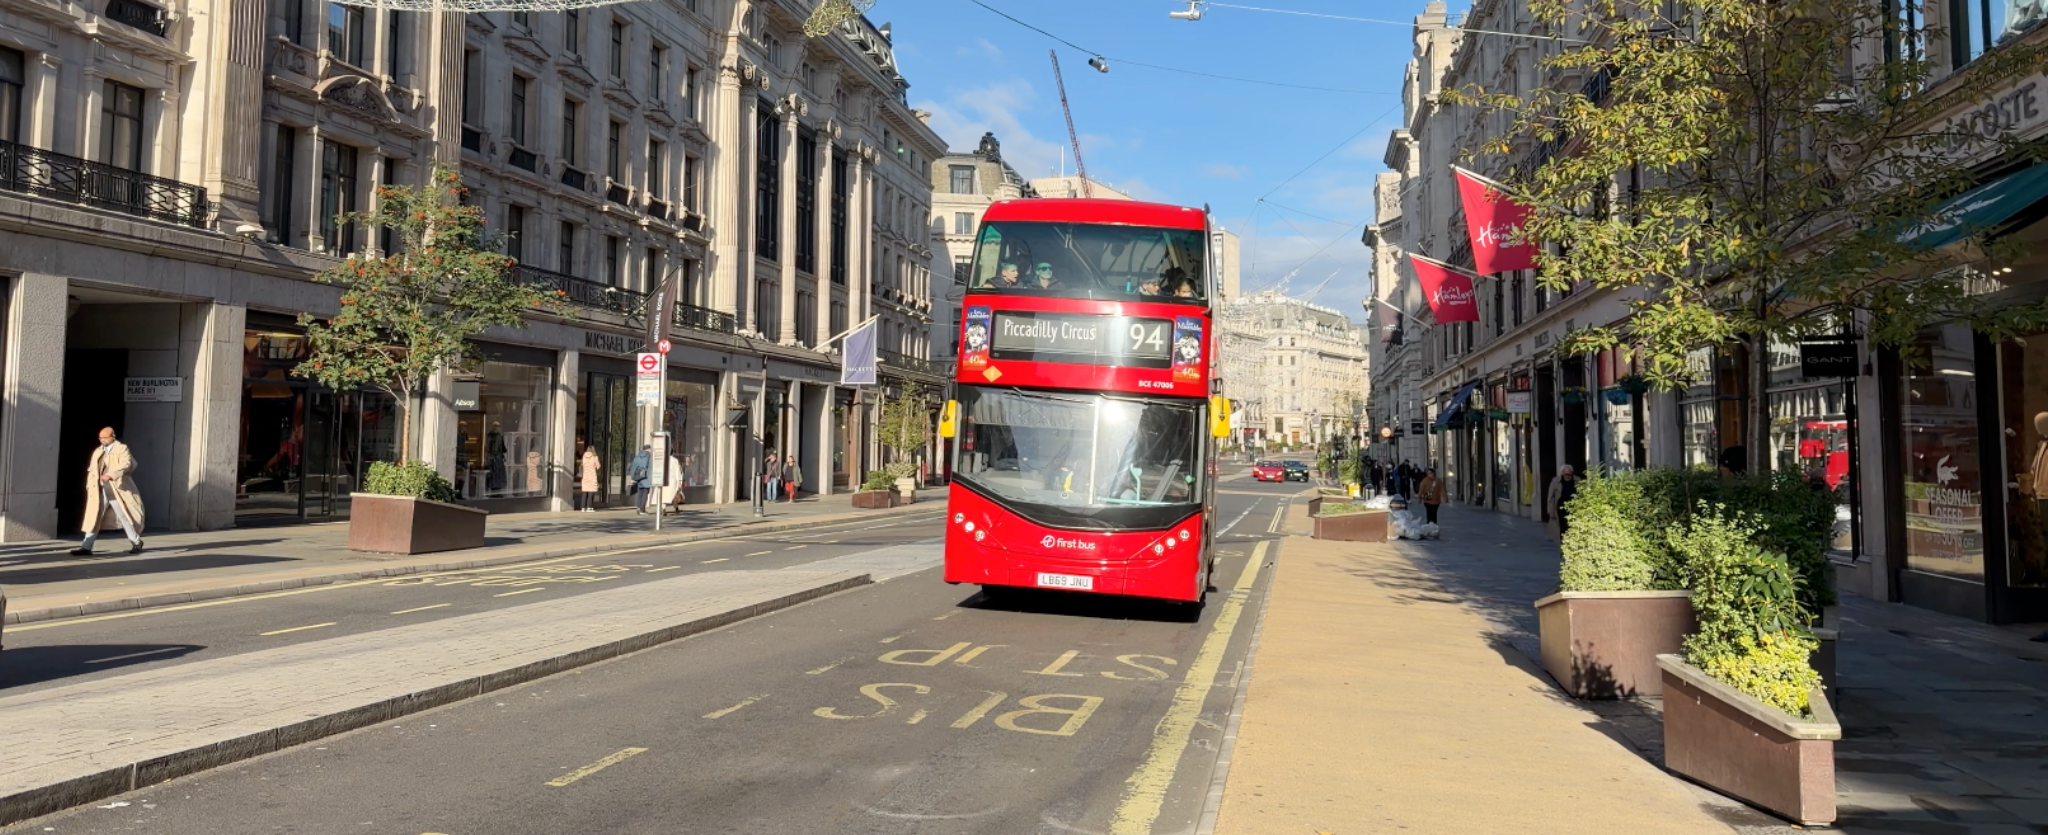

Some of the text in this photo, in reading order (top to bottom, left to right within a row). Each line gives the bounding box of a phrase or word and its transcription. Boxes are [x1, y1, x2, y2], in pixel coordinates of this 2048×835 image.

[1945, 82, 2038, 154] LOSTE
[1004, 318, 1097, 343] Piccadilly Circus
[1130, 323, 1164, 351] 94
[585, 331, 624, 353] MICHAEL
[660, 341, 668, 352] M
[1807, 356, 1853, 364] GANT
[127, 379, 179, 387] NEW BURLINGTON
[127, 387, 145, 395] PLACE
[1925, 486, 1974, 507] SEASONAL
[1935, 506, 1964, 526] OFFER
[1057, 538, 1096, 550] first bus
[1042, 574, 1088, 588] LB69 JNU
[812, 682, 1105, 736] BUS
